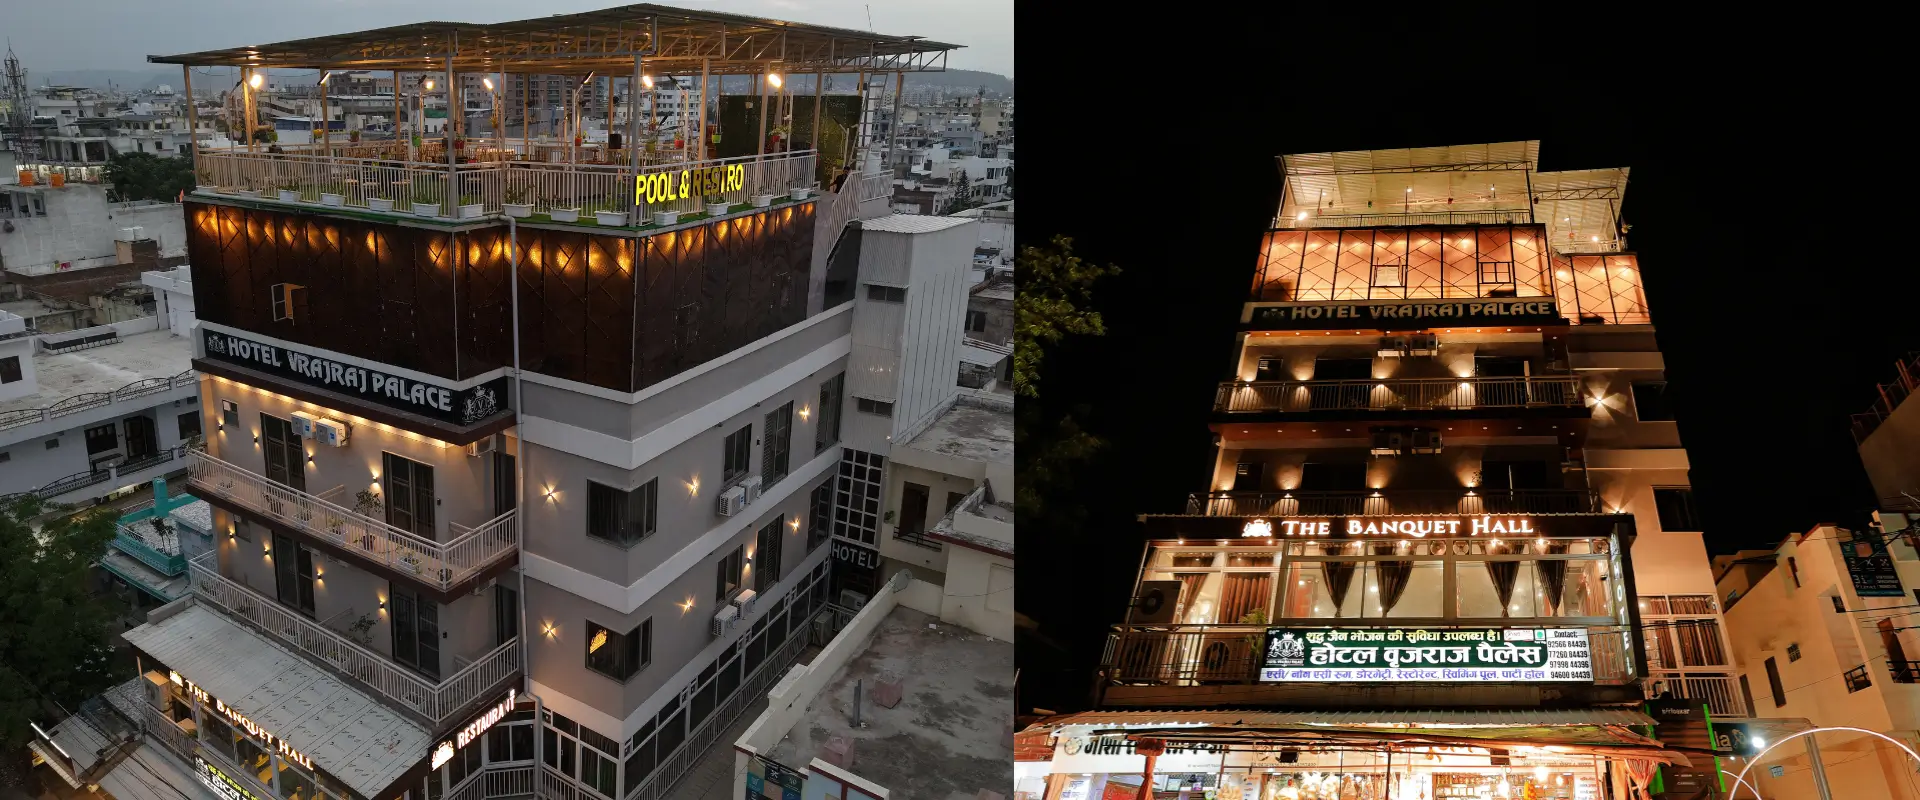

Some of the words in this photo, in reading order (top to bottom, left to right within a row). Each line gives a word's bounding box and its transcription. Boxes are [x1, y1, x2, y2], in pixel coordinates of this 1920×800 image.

[636, 173, 676, 205] POOL
[679, 169, 689, 199] &
[692, 163, 744, 197] RESTRO
[1291, 305, 1361, 319] HOTEL
[1369, 303, 1464, 320] VRAJRAJ
[1470, 302, 1551, 317] PALACE
[228, 337, 282, 368] HOTEL
[287, 350, 369, 393] VRAJRAJ
[372, 372, 453, 411] PALACE
[1281, 520, 1330, 535] THE
[1347, 519, 1461, 538] BANQUET
[1471, 516, 1534, 536] HALL
[831, 542, 875, 570] HOTEL
[1350, 630, 1385, 642] भोजन
[1387, 629, 1404, 642] की
[1406, 629, 1440, 643] सुविधा
[1442, 631, 1485, 642] उपलब्ध
[1309, 642, 1379, 665] होटल
[1383, 646, 1472, 668] वृजराज
[1476, 641, 1542, 664] पैलेस
[184, 679, 210, 703] THE
[216, 699, 274, 745] BANQUET
[278, 738, 314, 771] HALL
